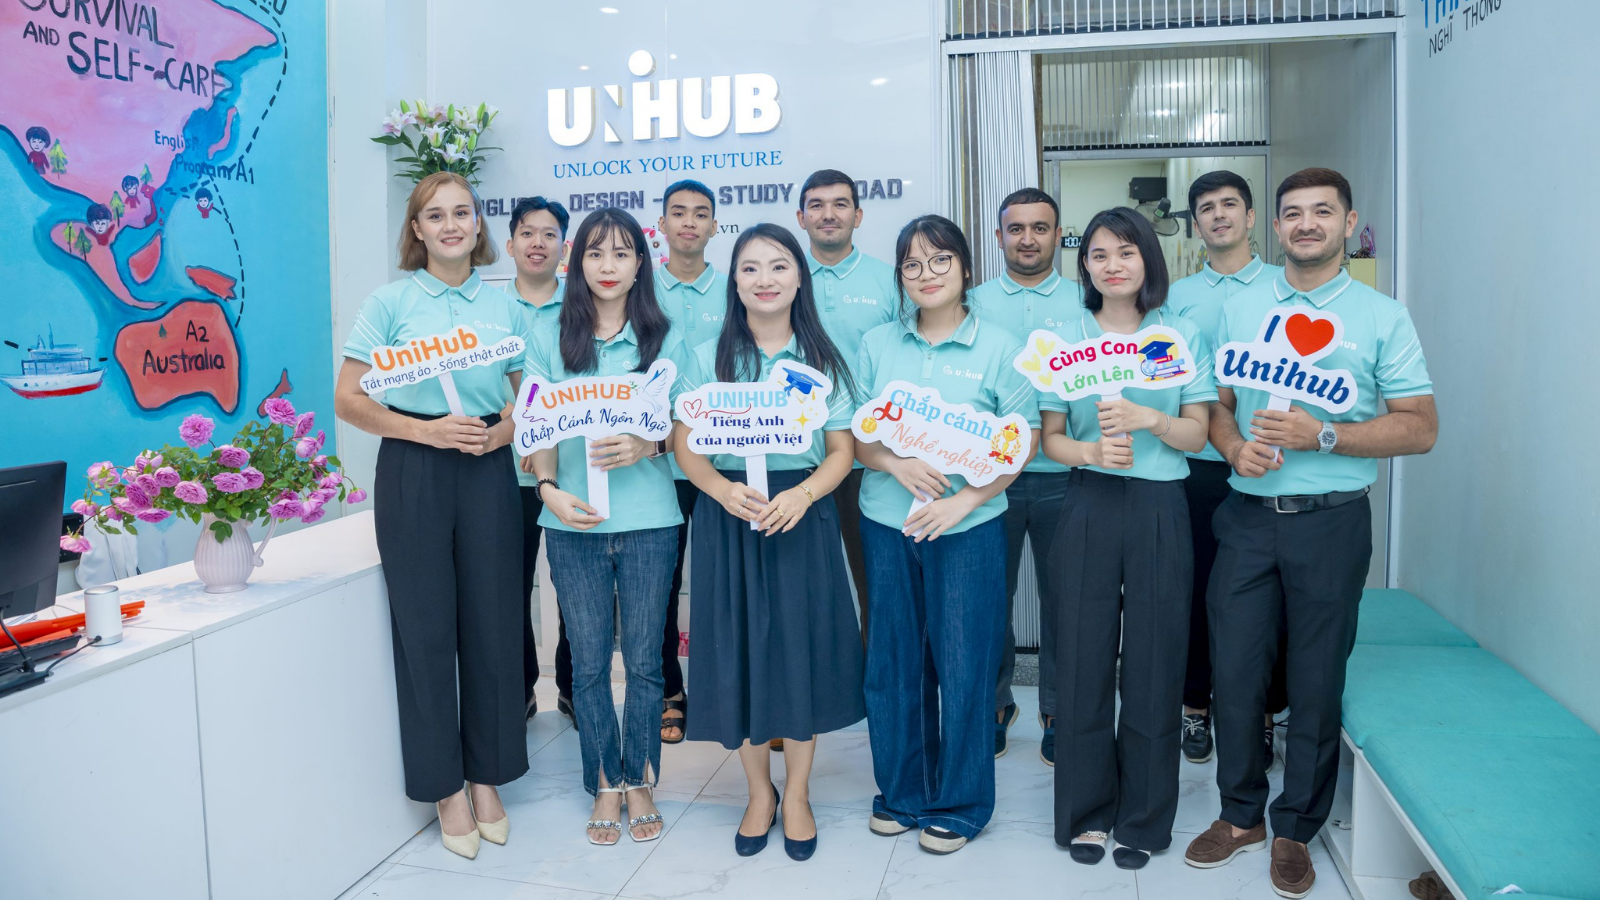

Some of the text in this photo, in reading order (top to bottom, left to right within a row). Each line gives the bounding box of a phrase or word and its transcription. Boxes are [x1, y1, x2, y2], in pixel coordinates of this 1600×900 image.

[23, 21, 60, 46] AND
[553, 150, 783, 178] UNLOCK YOUR FUTURE
[569, 190, 645, 212] DESIGN
[718, 183, 794, 204] STUDY
[186, 319, 209, 342] A2
[1263, 314, 1281, 343] I
[142, 347, 226, 376] Australia
[373, 328, 478, 371] UniHub
[1049, 341, 1138, 371] Cùng Con
[363, 376, 382, 391] Tắt
[384, 371, 416, 384] mạng
[417, 366, 431, 377] ảo
[440, 356, 468, 371] Sống
[469, 348, 493, 363] thật
[496, 341, 521, 356] chất
[1063, 365, 1134, 393] Lớn Lên
[1223, 349, 1350, 405] Unihub
[540, 383, 632, 410] UNIHUB
[707, 390, 788, 409] UNIHUB
[521, 424, 554, 448] Chắp
[558, 409, 595, 432] Cánh
[599, 408, 635, 427] Ngôn
[710, 414, 784, 429] Tiếng Anh
[890, 389, 993, 440] Chắp cánh
[696, 433, 803, 448] của người Việt
[937, 448, 993, 478] nghiệp
